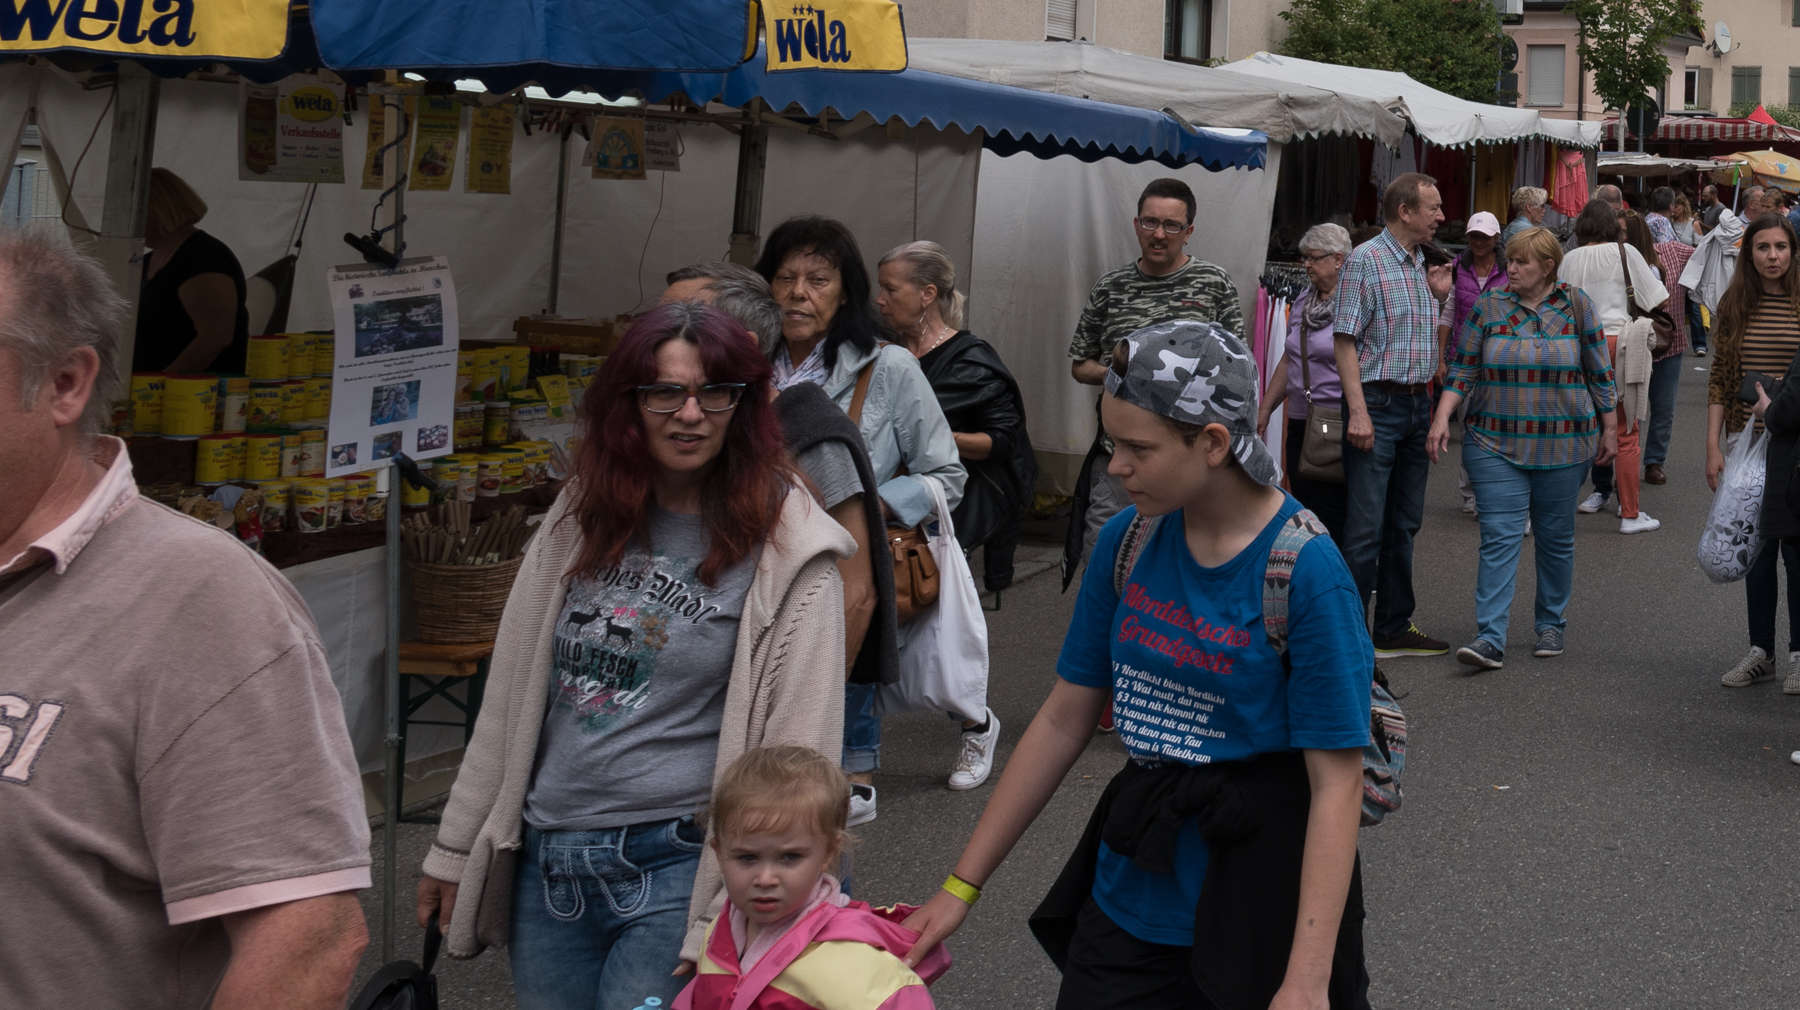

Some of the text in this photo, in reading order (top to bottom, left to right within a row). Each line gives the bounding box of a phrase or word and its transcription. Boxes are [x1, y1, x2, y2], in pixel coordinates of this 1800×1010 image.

[292, 91, 334, 113] wela
[280, 124, 342, 140] Verkaufsstelle
[1118, 614, 1235, 675] Grundgesetz
[590, 647, 639, 678] FESCH
[613, 679, 652, 710] di
[1115, 677, 1215, 713] §2 Wat mutt, dat mutt
[1121, 664, 1162, 686] Nordlicht
[1162, 678, 1186, 694] bleibt
[1186, 686, 1226, 706] Nordlicht
[1115, 691, 1209, 725] §3 von nix kommt nix
[1122, 706, 1161, 725] kannssu
[1161, 718, 1177, 729] nix
[1177, 722, 1191, 732] an
[1191, 725, 1226, 739] machen
[1123, 720, 1138, 733] Na
[1138, 725, 1160, 739] denn
[1160, 732, 1183, 745] man
[1184, 735, 1203, 748] Tau
[1151, 741, 1160, 753] is
[1161, 743, 1212, 764] Tüdelkram
